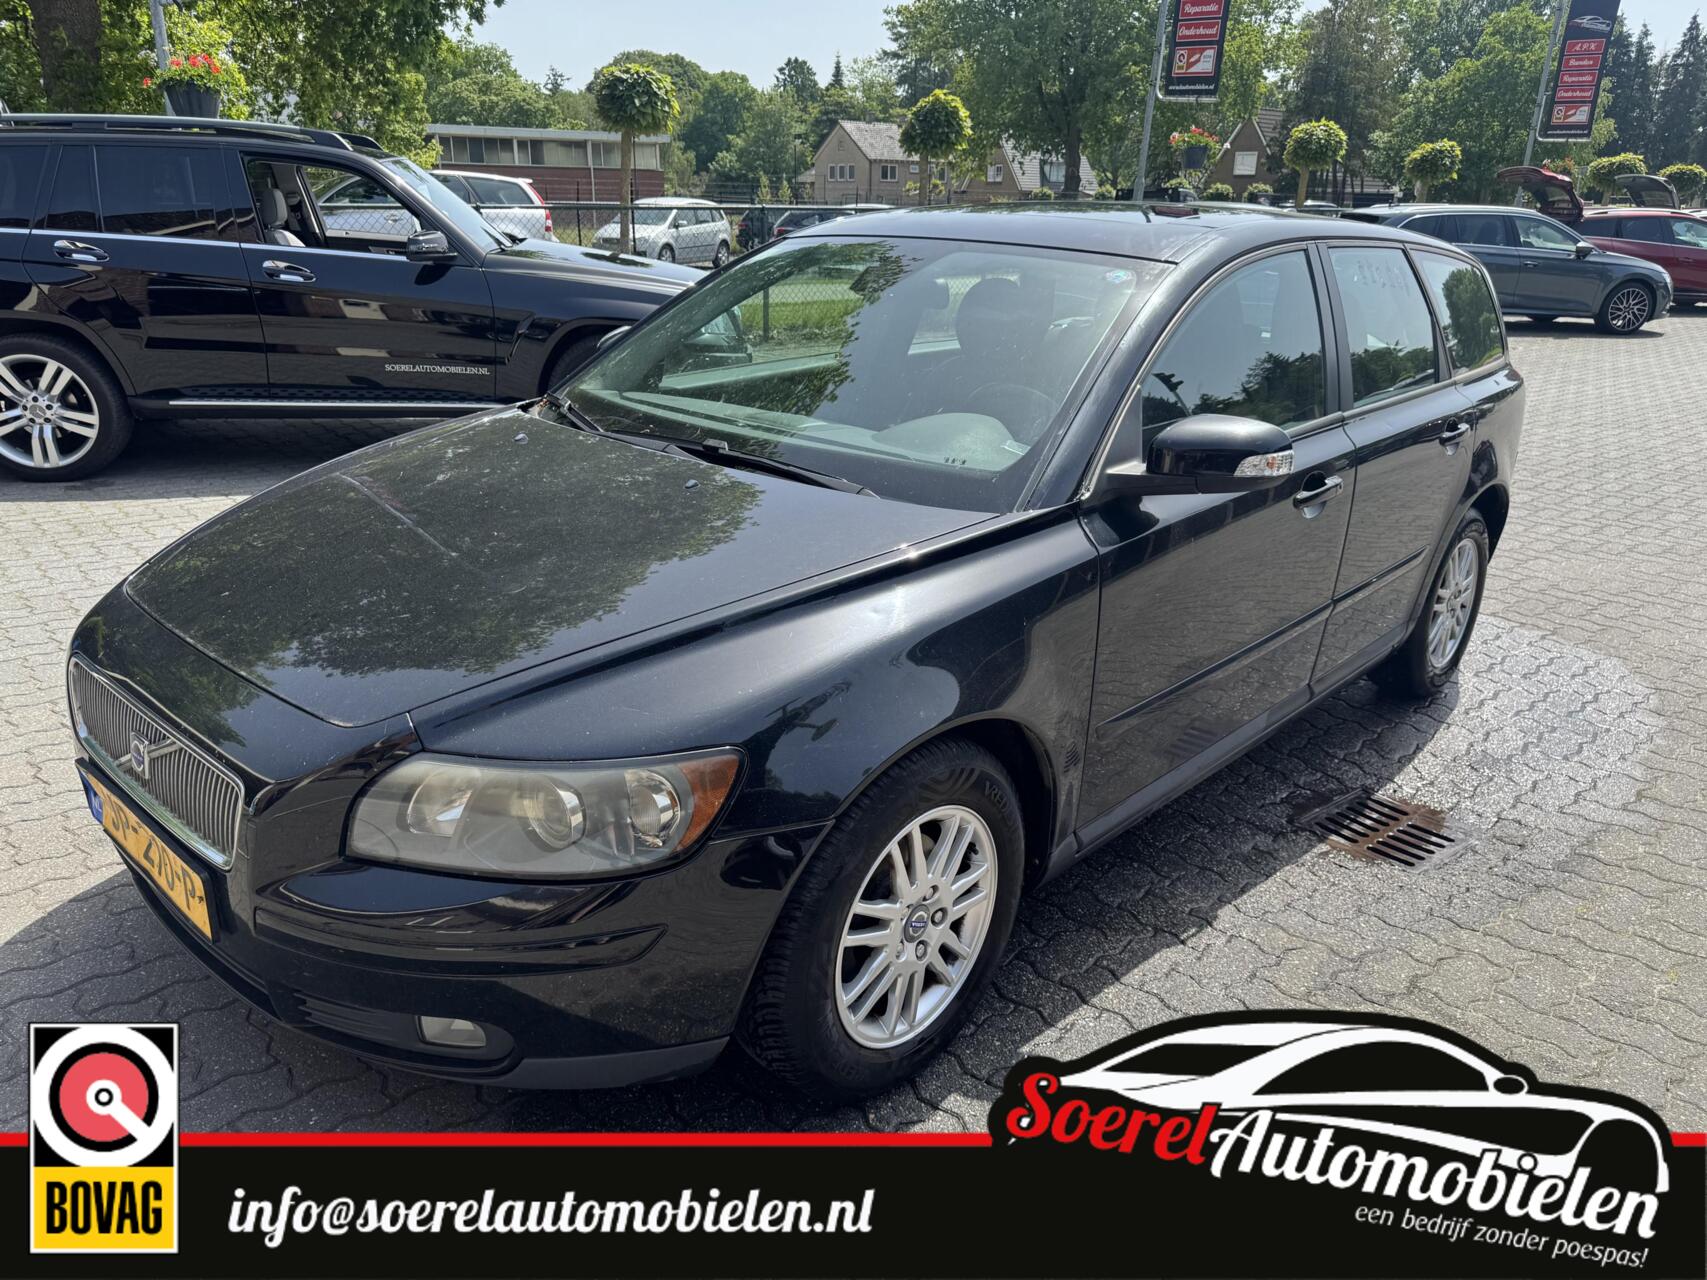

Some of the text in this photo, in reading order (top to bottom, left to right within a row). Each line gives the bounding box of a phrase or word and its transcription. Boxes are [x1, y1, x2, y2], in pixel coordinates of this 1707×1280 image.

[1184, 3, 1219, 14] Reparatie
[1179, 25, 1218, 36] Onderhoud
[385, 364, 491, 375] SOERELAUTOMOBIELEN.NL
